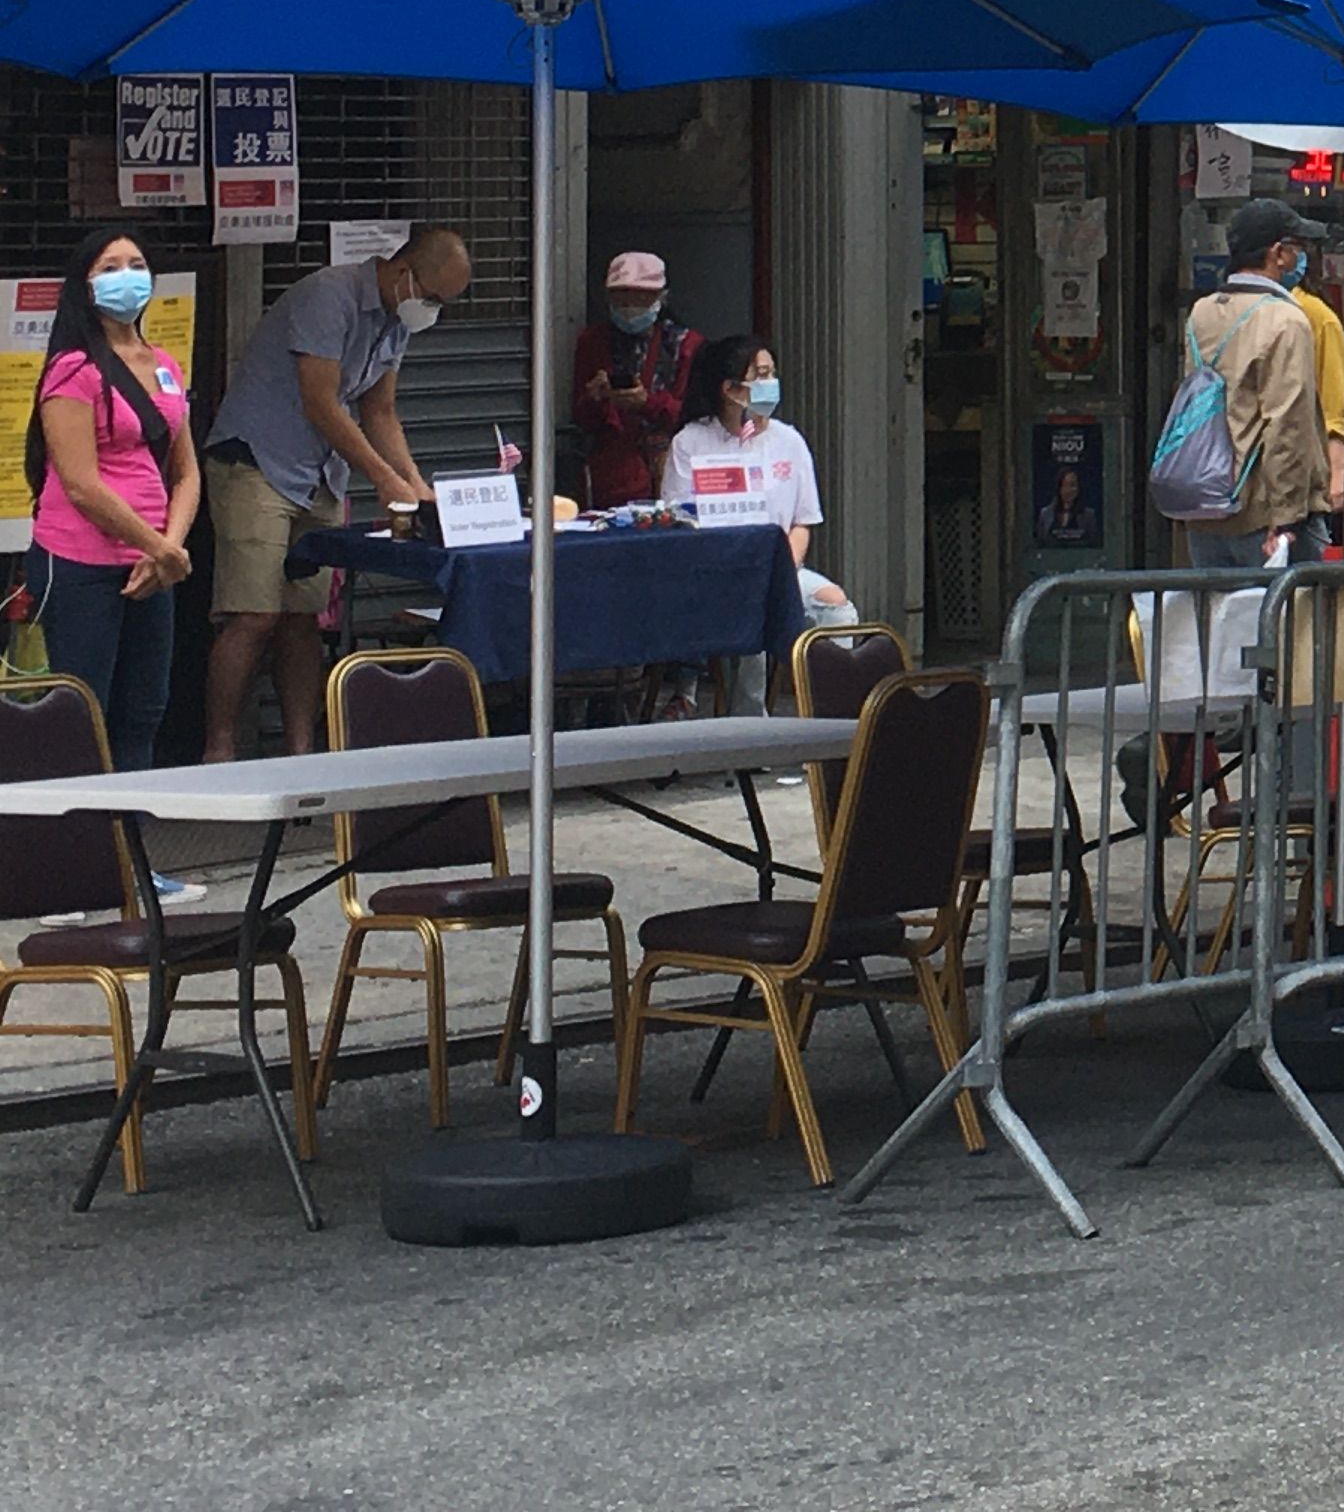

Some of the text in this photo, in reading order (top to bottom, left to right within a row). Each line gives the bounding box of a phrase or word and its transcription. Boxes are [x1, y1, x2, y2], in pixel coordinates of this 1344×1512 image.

[121, 81, 199, 109] Register
[161, 109, 196, 130] and
[233, 131, 292, 164] 投票
